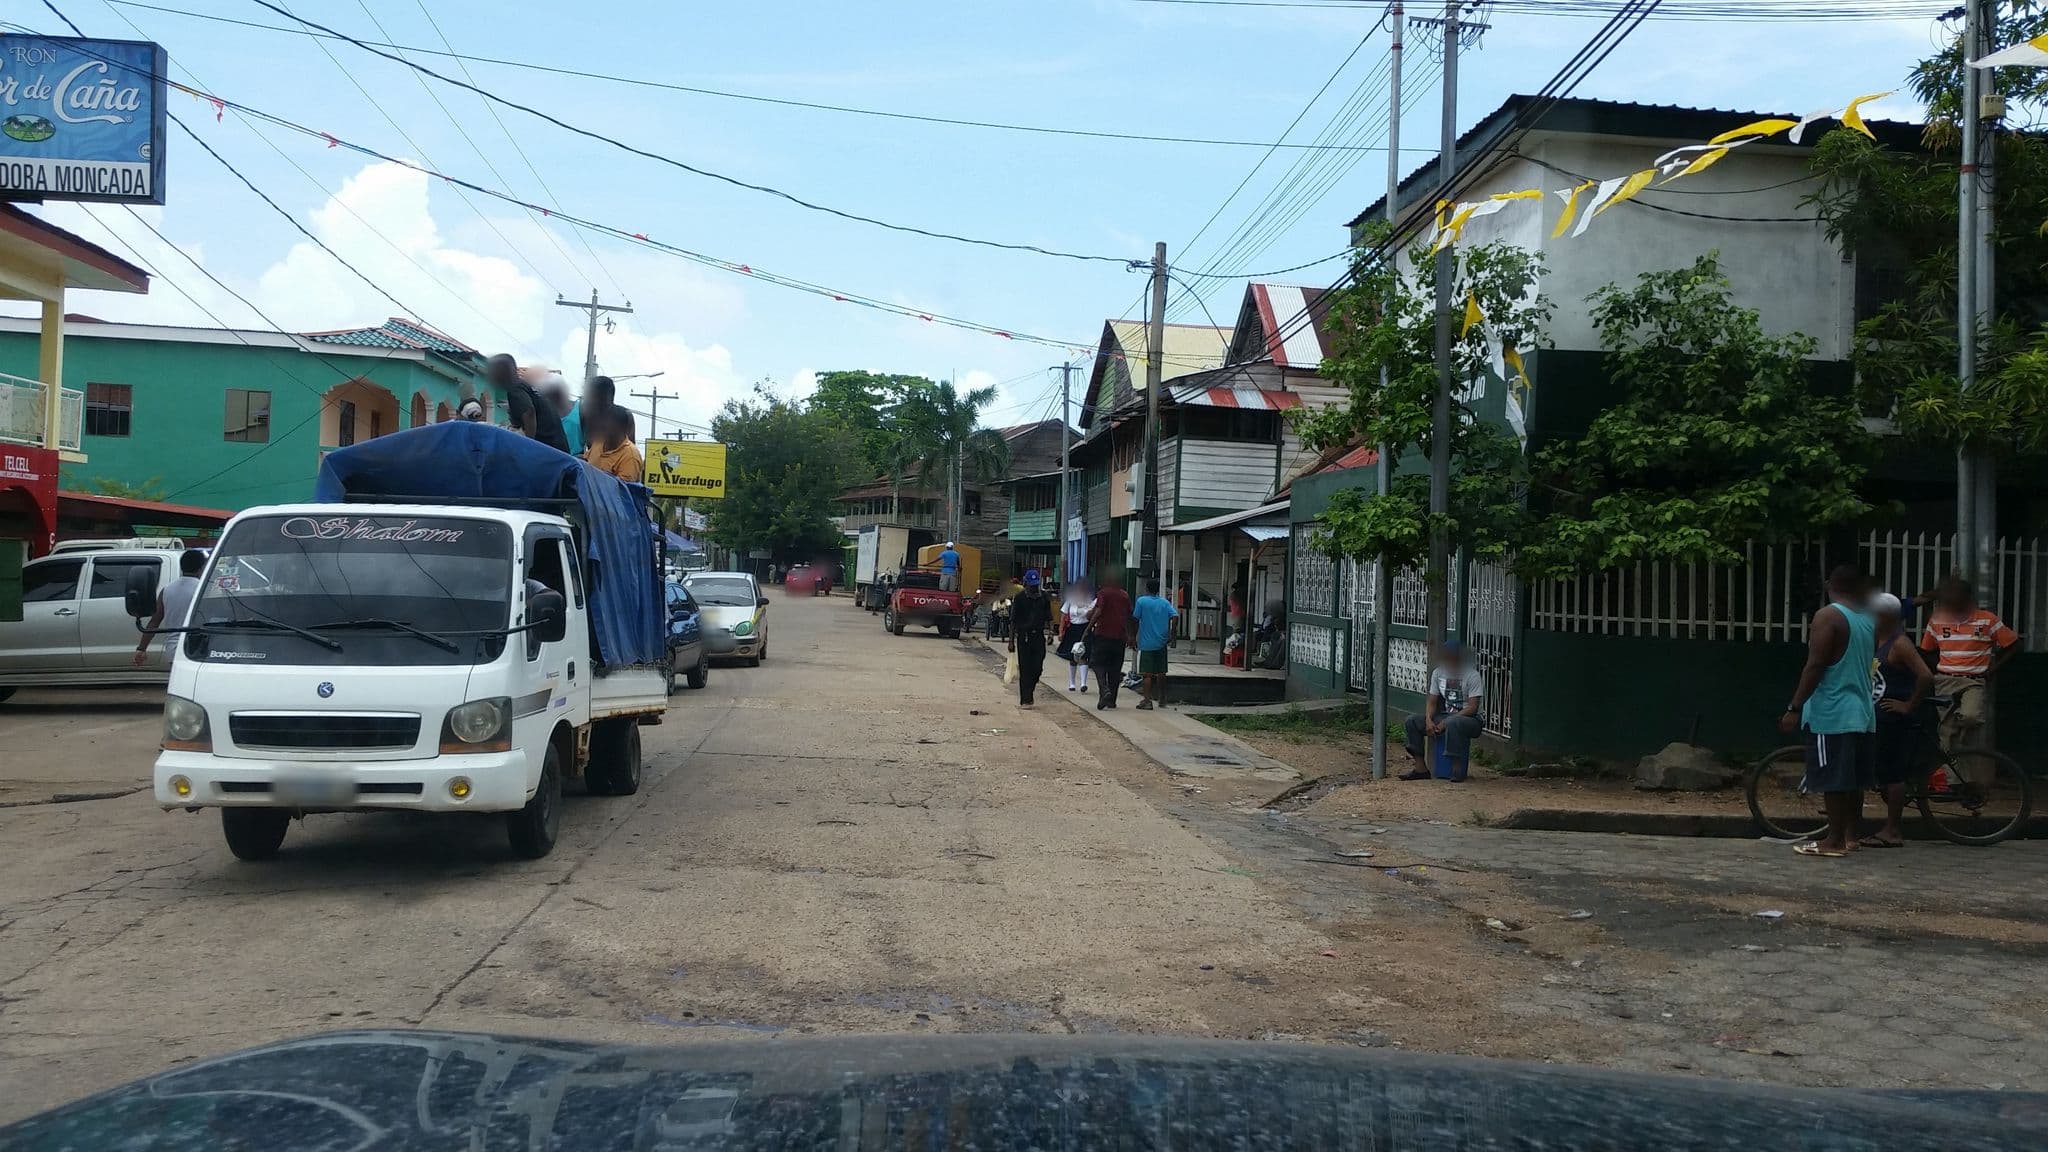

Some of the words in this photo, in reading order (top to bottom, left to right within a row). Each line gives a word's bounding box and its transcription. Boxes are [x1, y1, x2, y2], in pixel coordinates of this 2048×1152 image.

[9, 47, 57, 67] RON
[23, 74, 52, 100] de
[53, 60, 141, 125] Caña
[0, 162, 48, 192] DORA
[55, 165, 146, 195] MONCADA
[4, 455, 30, 472] TELCELL
[648, 472, 660, 484] El
[671, 474, 722, 489] Verdugo
[280, 517, 464, 543] Shalom
[1942, 627, 1951, 639] 5
